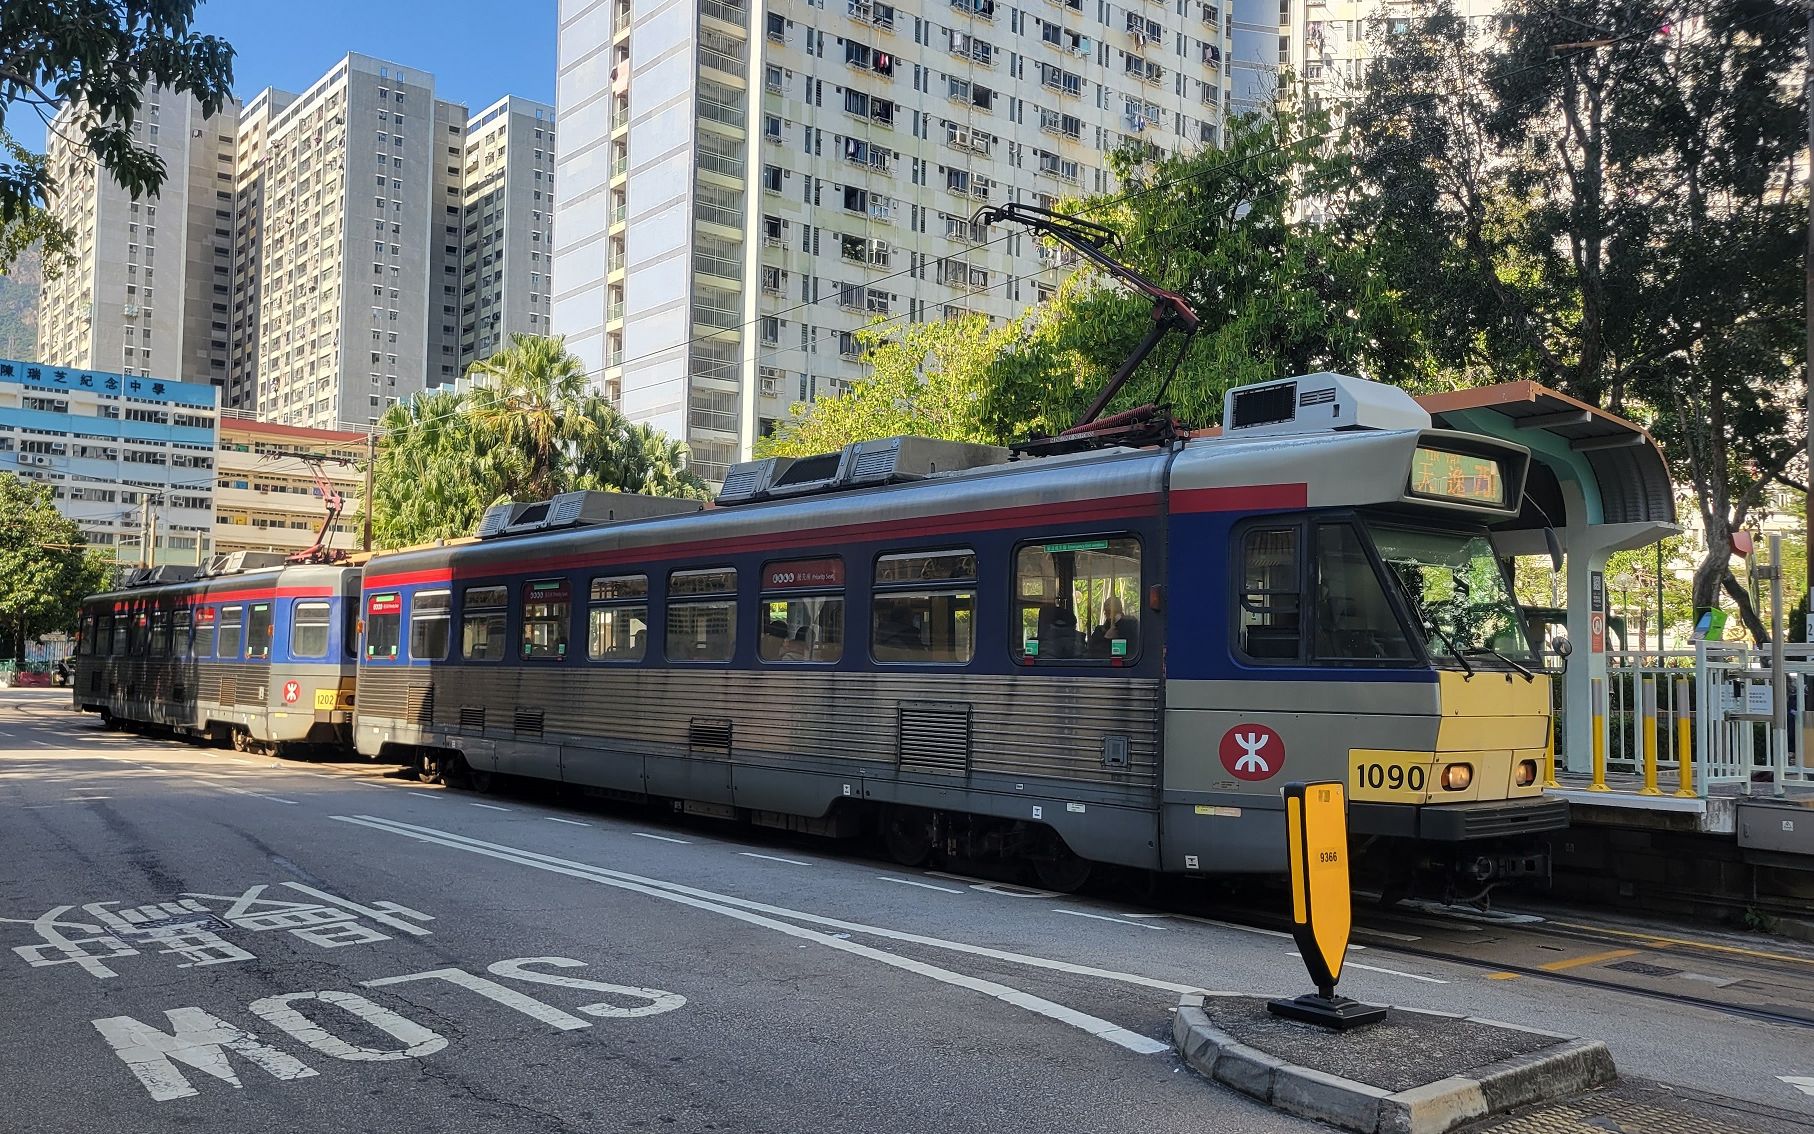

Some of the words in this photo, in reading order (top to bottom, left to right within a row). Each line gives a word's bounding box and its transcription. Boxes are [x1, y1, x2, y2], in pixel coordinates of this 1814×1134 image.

[0, 363, 166, 395] 陳瑞芝紀念中學
[317, 694, 335, 705] 1202
[1357, 763, 1425, 791] 1090
[1319, 851, 1338, 863] 9366
[90, 956, 688, 1102] SLOW
